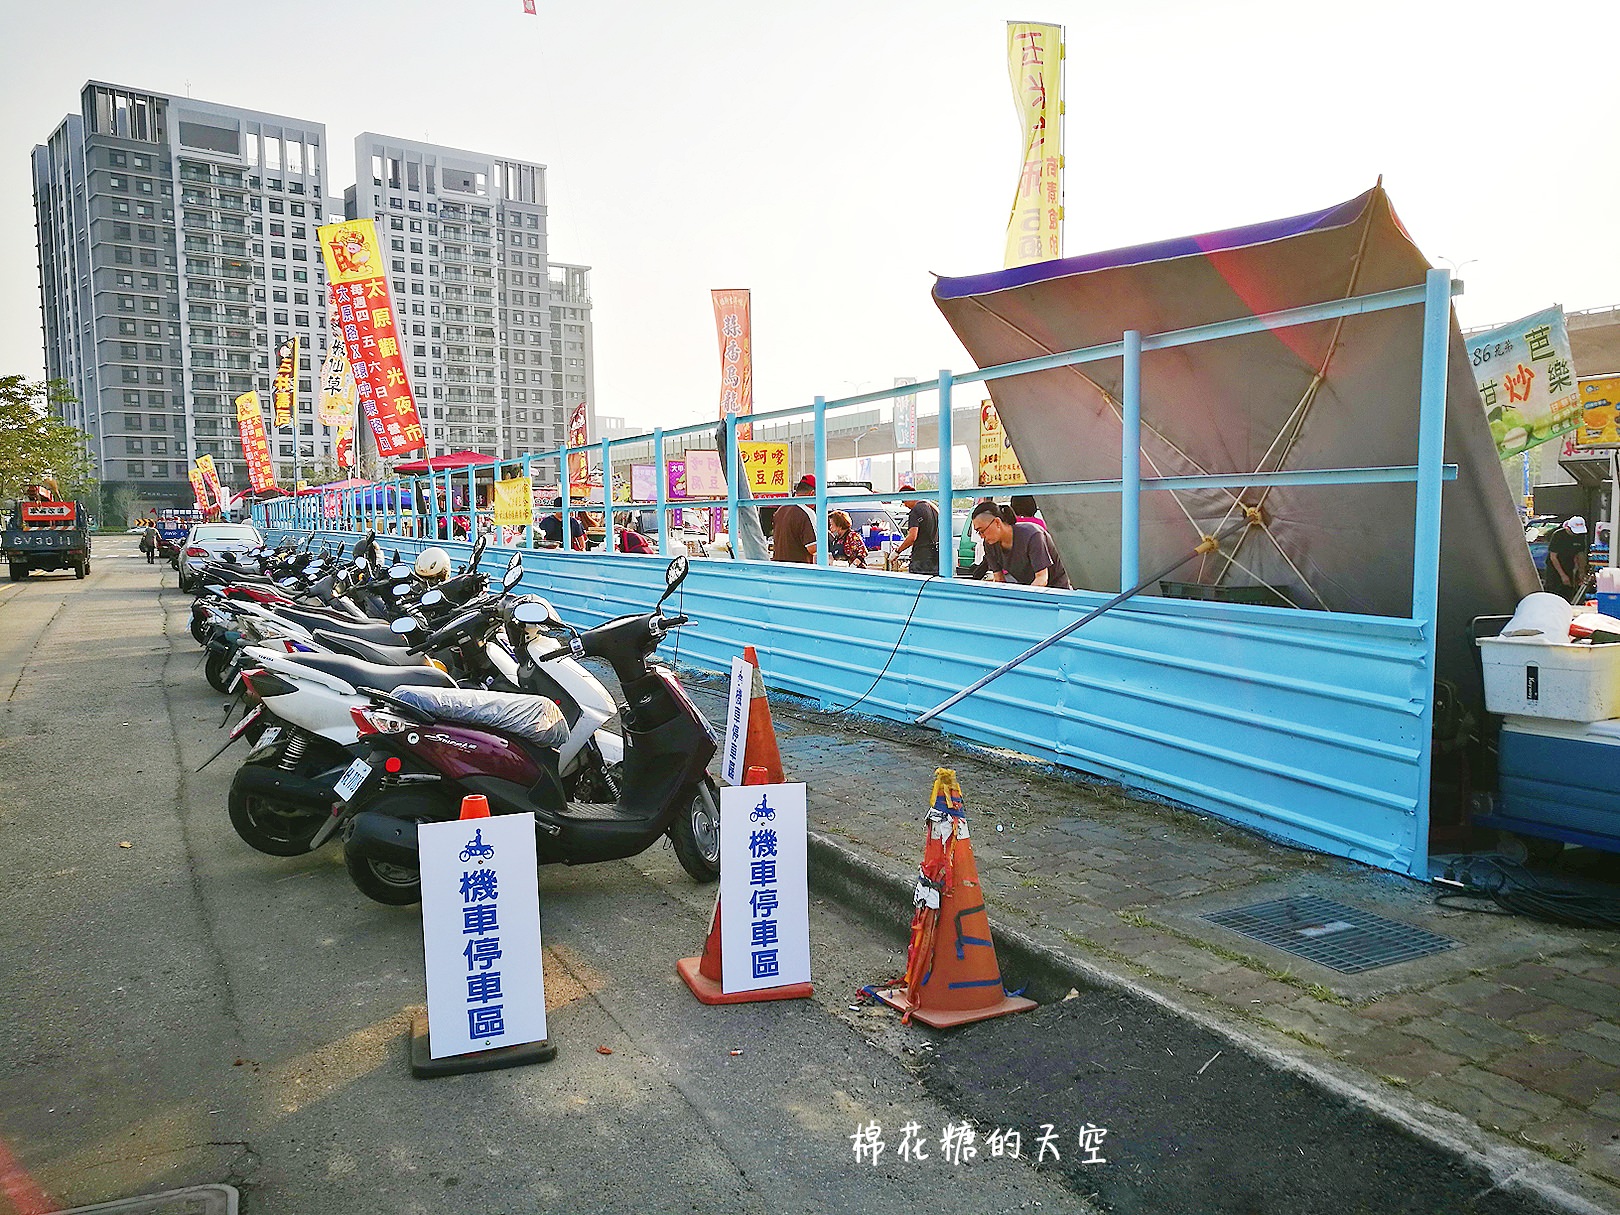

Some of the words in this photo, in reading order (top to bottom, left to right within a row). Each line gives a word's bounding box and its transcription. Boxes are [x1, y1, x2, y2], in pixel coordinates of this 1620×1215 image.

[365, 279, 423, 442] 太原觀光夜市
[721, 314, 742, 436] 蒜香烏龍
[749, 469, 785, 486] 豆腐
[459, 868, 505, 1040] 機車停車區
[749, 829, 779, 978] 機車停車區
